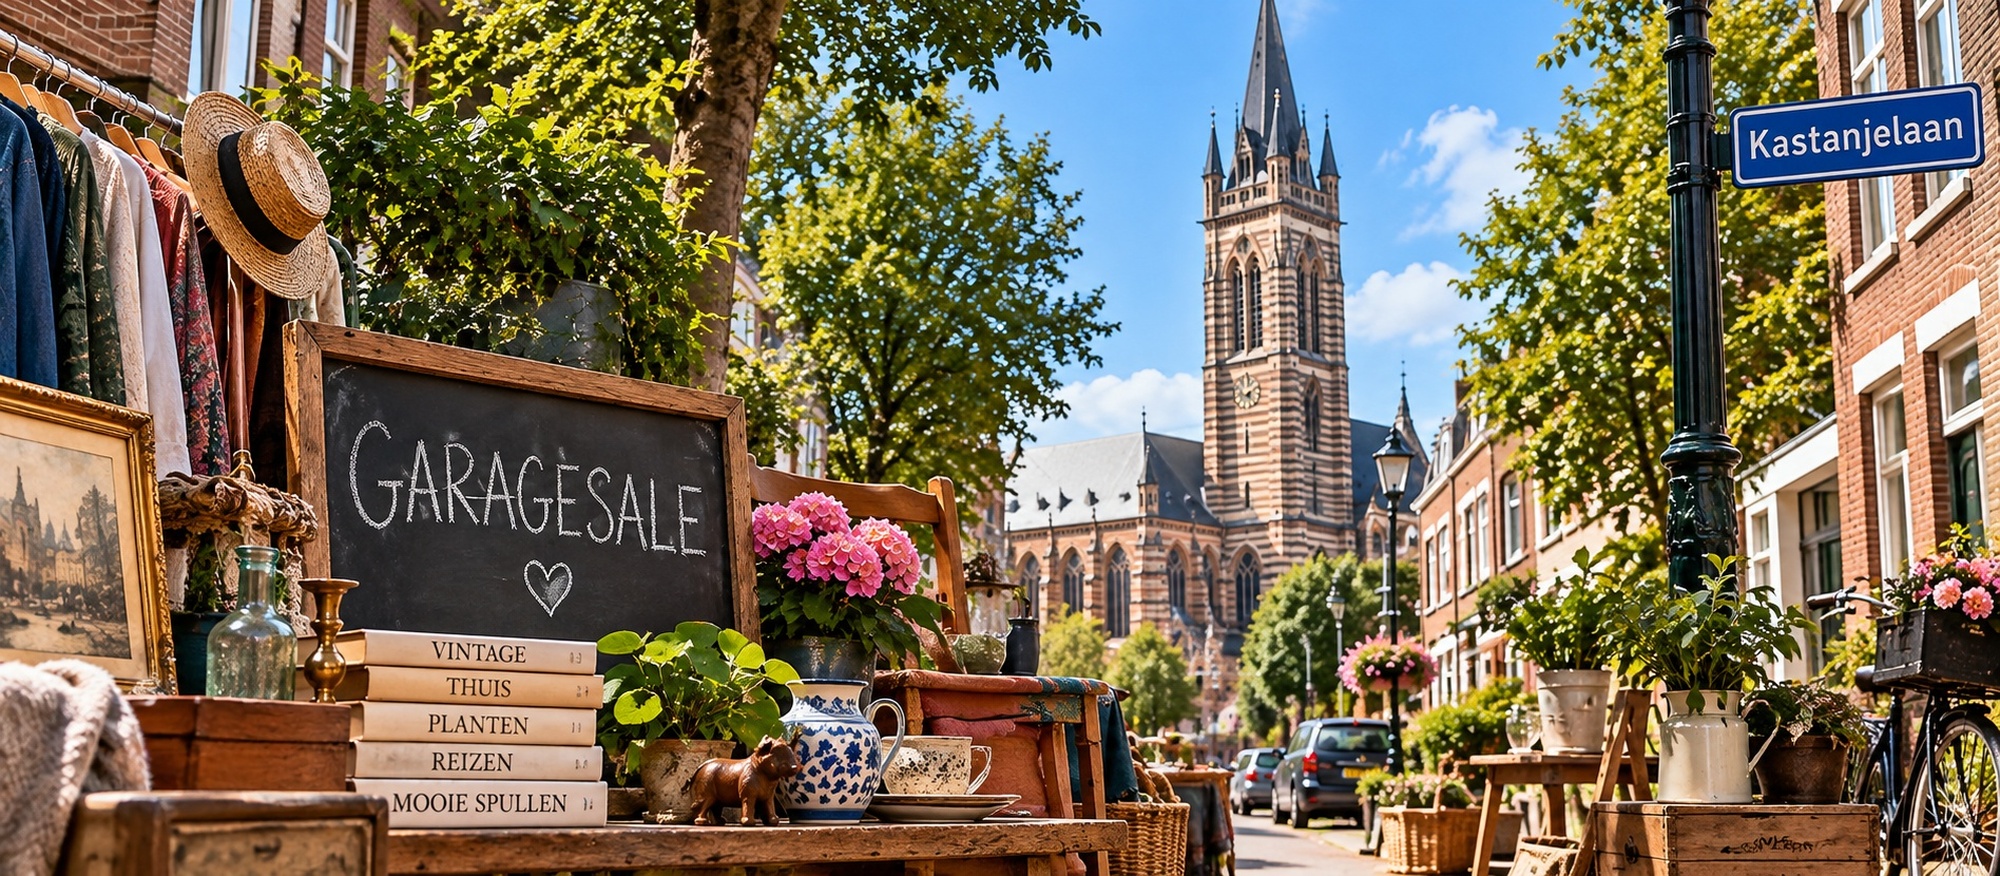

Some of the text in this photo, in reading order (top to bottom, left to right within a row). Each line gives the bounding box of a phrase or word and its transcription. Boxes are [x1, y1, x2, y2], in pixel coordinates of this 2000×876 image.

[1749, 115, 1963, 160] Kastanjelaan
[348, 419, 706, 557] GARAGESALE
[431, 640, 527, 664] VINTAGE
[446, 676, 512, 698] THUIS
[428, 713, 529, 735] PLANTEN
[431, 752, 514, 772] REIZEN
[391, 792, 468, 813] MOOIE
[474, 792, 568, 813] SPULLEN
